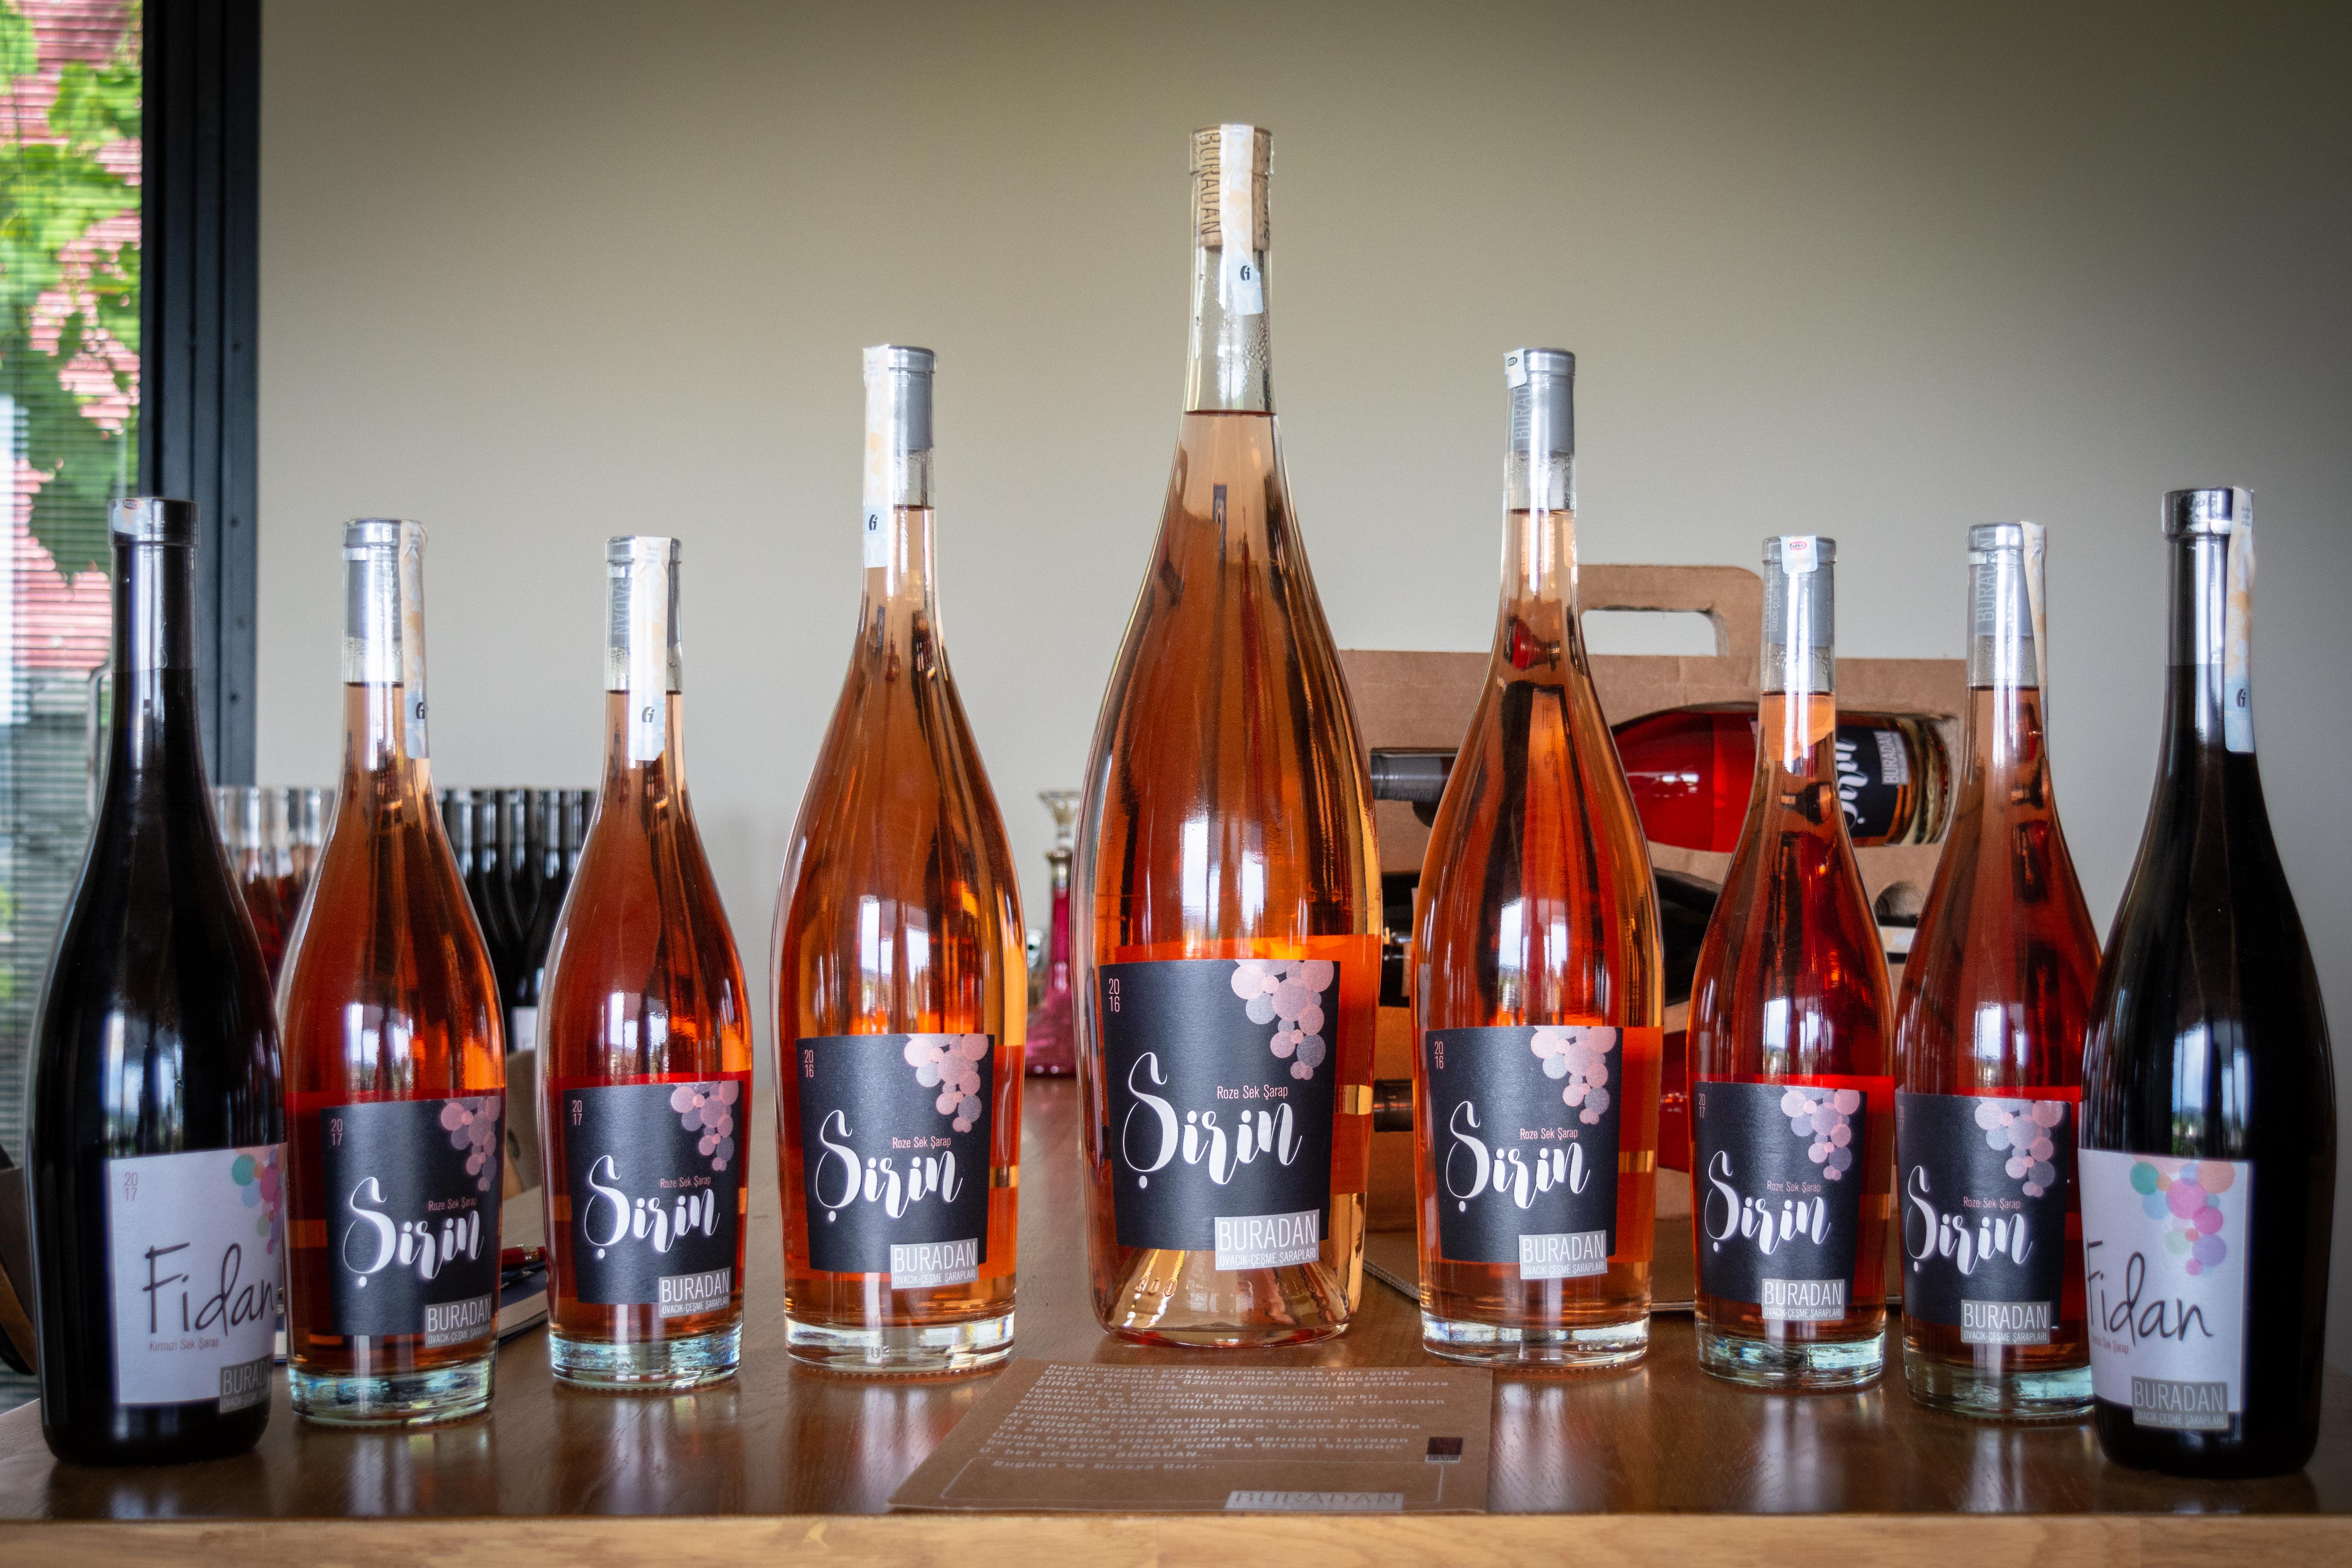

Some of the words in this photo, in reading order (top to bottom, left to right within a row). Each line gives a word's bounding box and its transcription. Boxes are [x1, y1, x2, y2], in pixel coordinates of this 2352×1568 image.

[1514, 387, 1532, 440] BURAD
[1109, 978, 1120, 995] 20
[1109, 996, 1120, 1012] 16
[1434, 1041, 1443, 1054] 20
[805, 1050, 814, 1063] 20
[1435, 1056, 1443, 1069] 16
[805, 1064, 814, 1078] 16
[1217, 1085, 1239, 1100] Roze
[1243, 1085, 1260, 1099] Sek
[1263, 1084, 1288, 1100] Şarap
[572, 1100, 582, 1113] 20
[1699, 1094, 1705, 1106] 20
[1699, 1106, 1705, 1118] 17
[331, 1119, 343, 1131] 20
[573, 1113, 582, 1126] 17
[331, 1133, 342, 1146] 17
[1520, 1128, 1538, 1140] Roze
[1541, 1127, 1555, 1139] Sek
[1558, 1127, 1578, 1140] Şarap
[893, 1137, 911, 1149] Roze
[914, 1137, 928, 1148] Sek
[930, 1136, 951, 1149] Şarap
[125, 1173, 138, 1186] 20
[660, 1178, 677, 1188] Roze
[679, 1177, 692, 1187] Sek
[694, 1176, 711, 1188] Şarap
[1767, 1180, 1783, 1191] Roze
[1786, 1181, 1799, 1192] Sek
[1802, 1182, 1821, 1194] Şarap
[125, 1188, 137, 1201] 17
[429, 1200, 445, 1211] Roze
[448, 1198, 459, 1209] Sek
[462, 1197, 477, 1209] Şarap
[1963, 1197, 1980, 1207] Roze
[1983, 1197, 1996, 1208] Sek
[2000, 1198, 2020, 1210] Şarap
[1219, 1214, 1316, 1251] BURADAN
[1523, 1234, 1604, 1264] BURADAN
[894, 1242, 976, 1273] BURADAN
[143, 1242, 274, 1337] Fidan
[662, 1271, 729, 1303] BURADAN
[1765, 1282, 1841, 1305] BURADAN
[2086, 1237, 2214, 1346] Fidan
[428, 1297, 491, 1332] BURADAN
[1964, 1303, 2047, 1329] BURADAN
[181, 1338, 196, 1349] Sek
[2134, 1381, 2222, 1411] BURADAN
[1236, 1492, 1395, 1504] BURADAN
